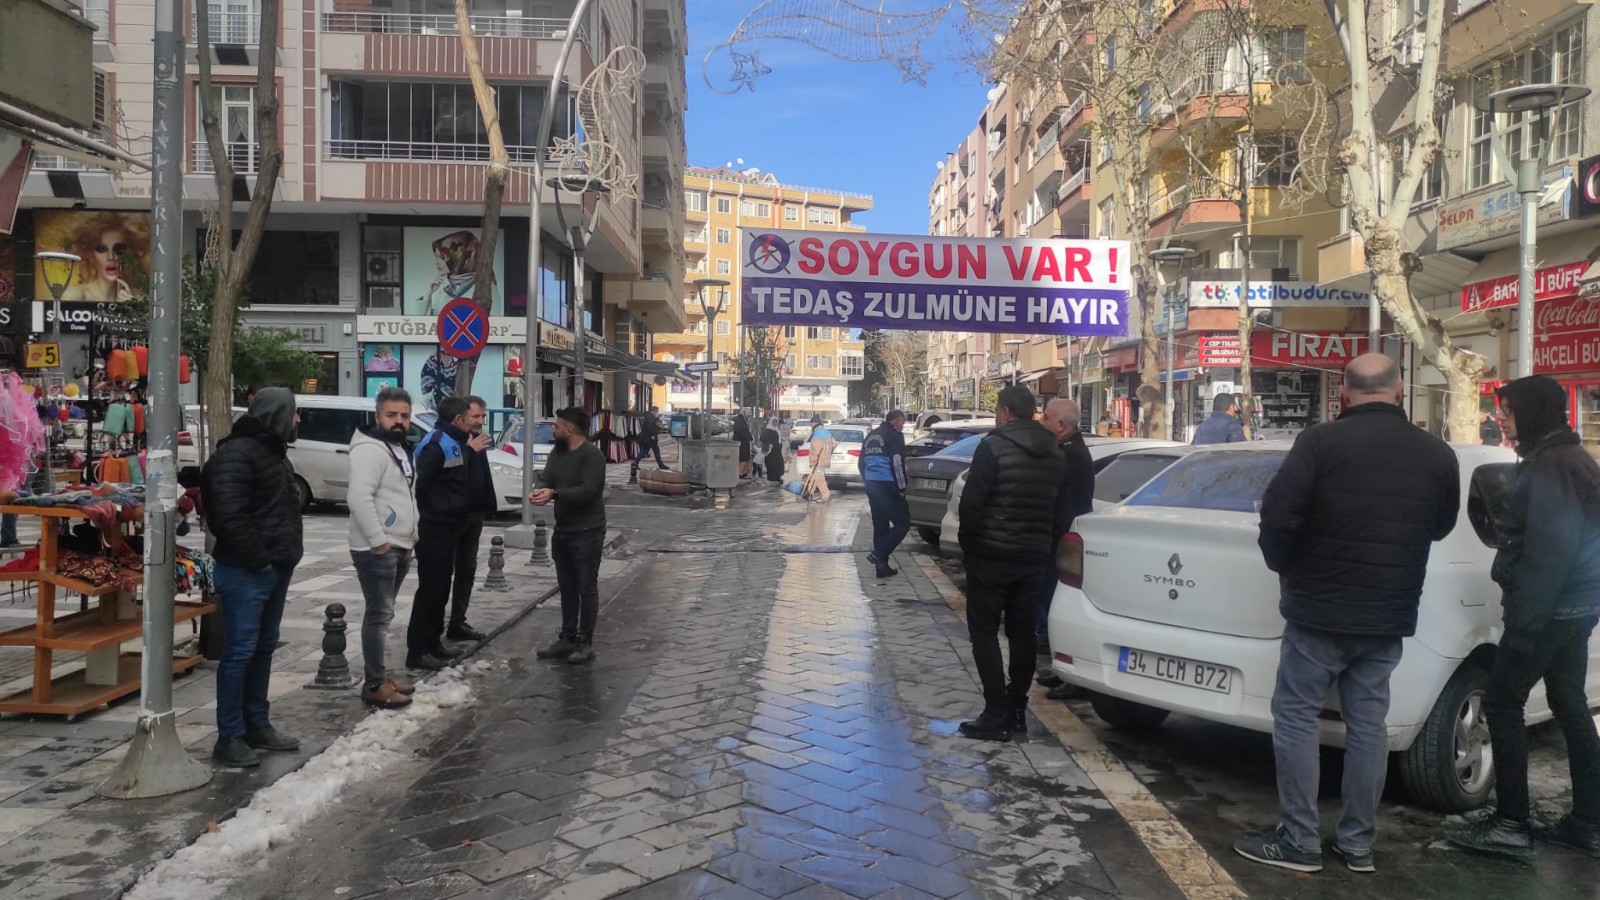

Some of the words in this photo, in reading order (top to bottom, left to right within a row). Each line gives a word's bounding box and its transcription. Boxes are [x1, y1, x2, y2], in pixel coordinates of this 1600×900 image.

[798, 237, 987, 281] SOYGUN
[1001, 245, 1093, 283] VAR
[1547, 268, 1582, 292] BÜFE
[751, 286, 854, 322] TEDAŞ
[863, 289, 1016, 323] ZULMÜNE
[1027, 298, 1119, 325] HAYIR
[373, 319, 438, 336] TUĞBA
[45, 346, 56, 365] 5
[1271, 332, 1367, 358] FIRAT
[1143, 574, 1196, 588] SYMBO
[1128, 651, 1147, 673] 34
[1155, 656, 1187, 682] CCM
[1194, 666, 1228, 690] 872
